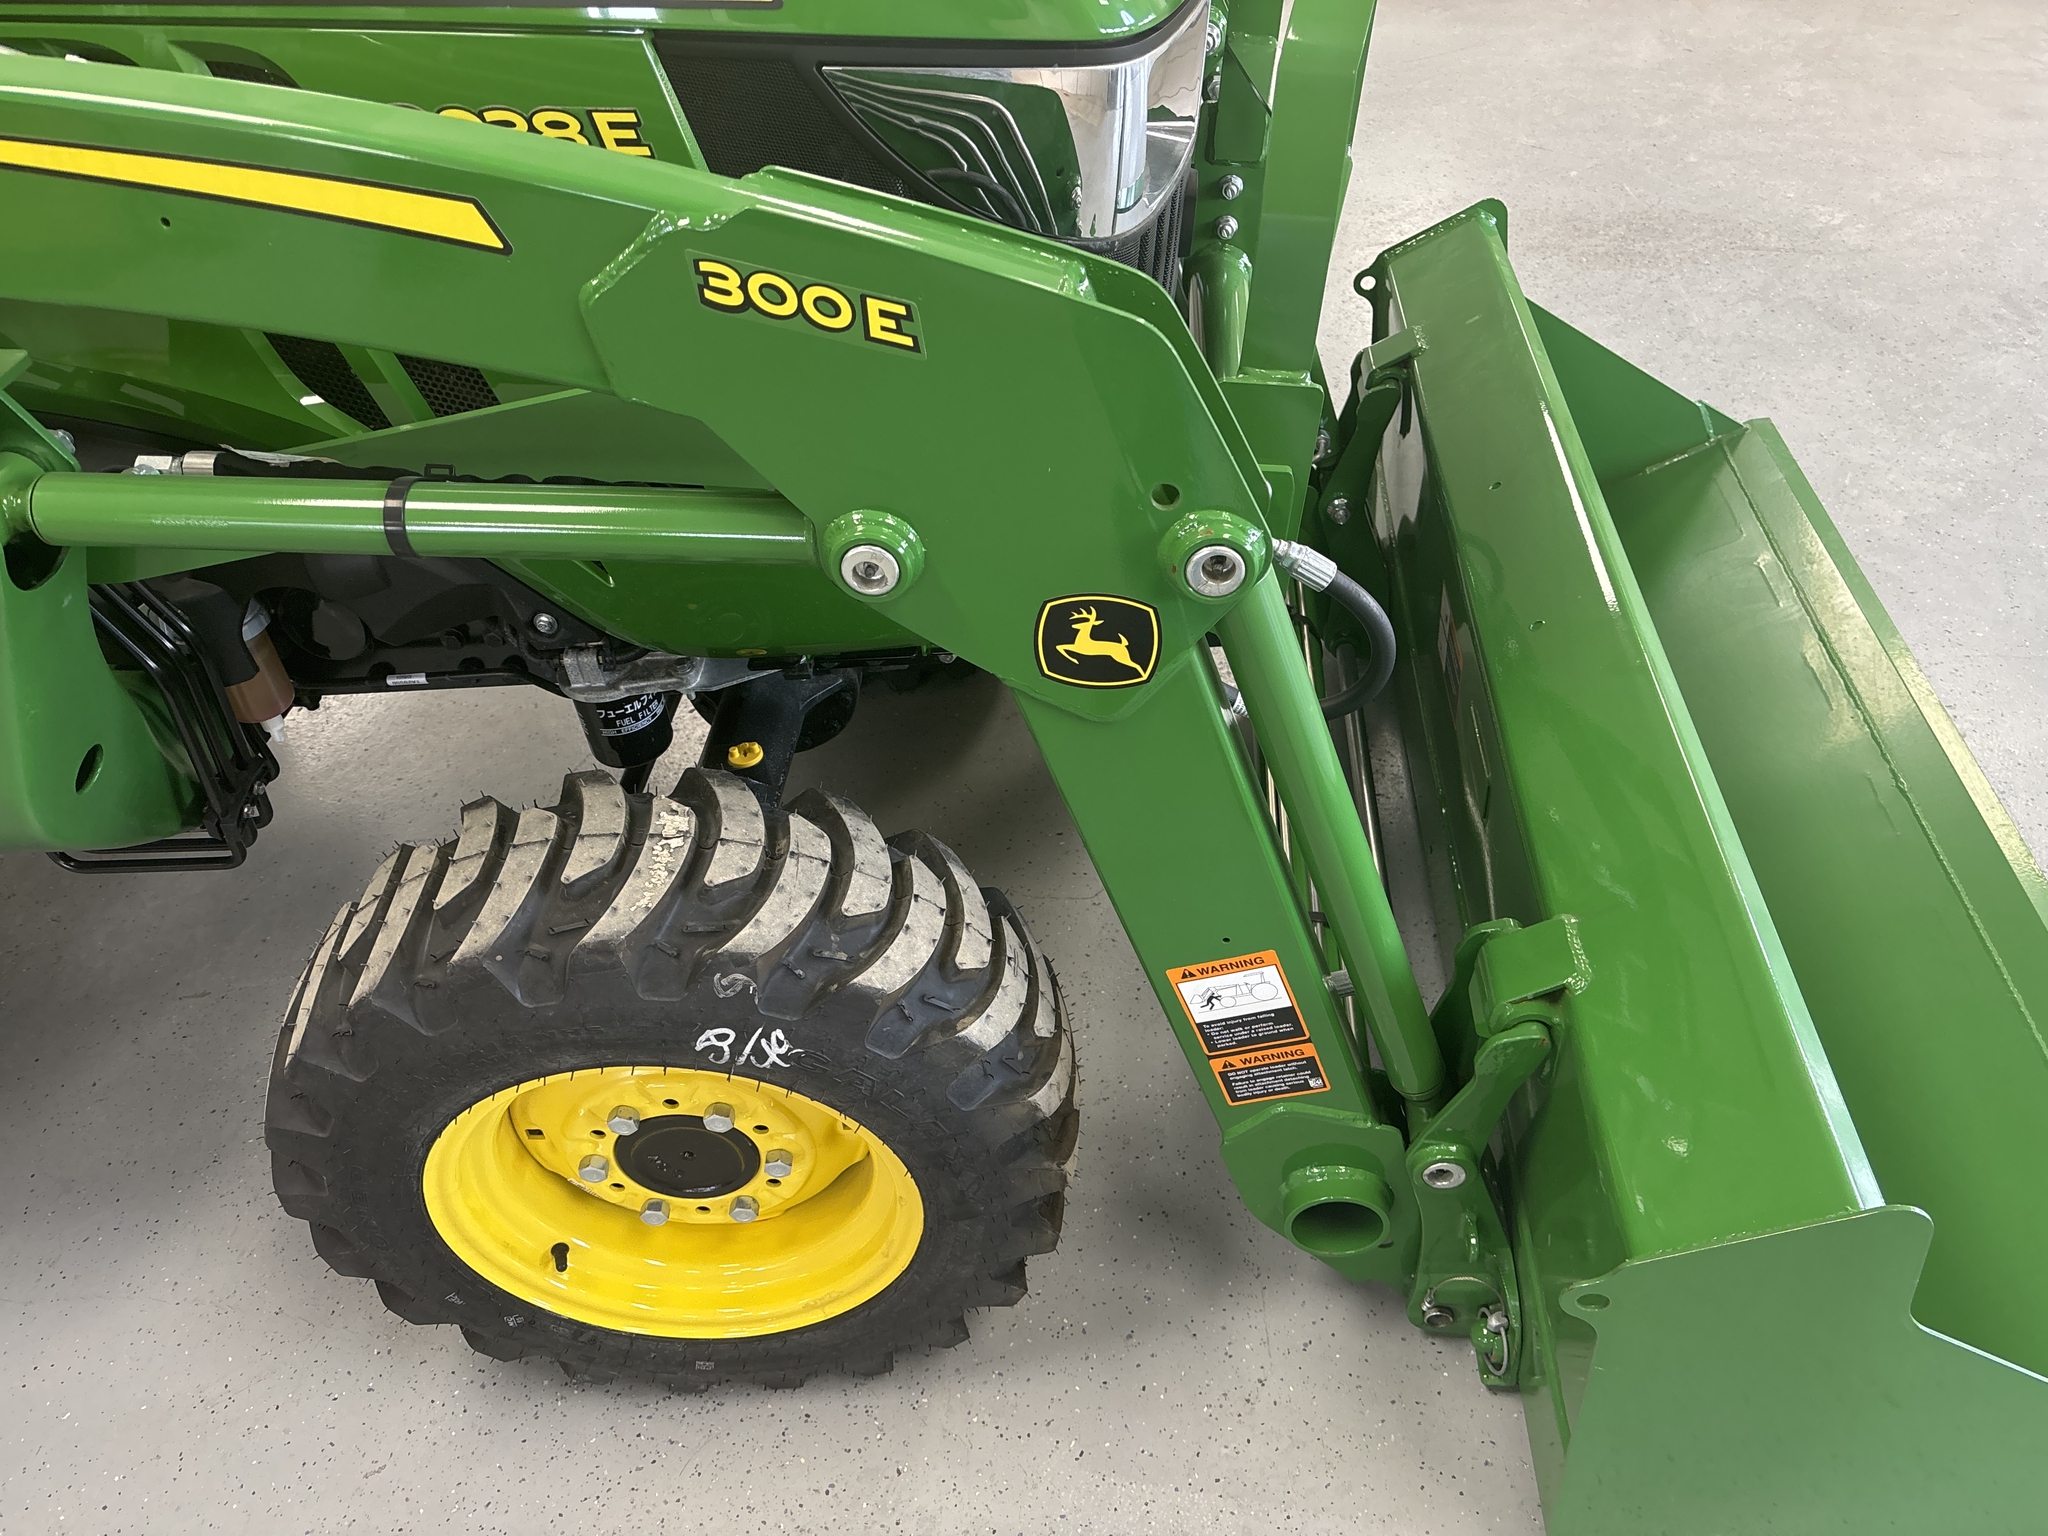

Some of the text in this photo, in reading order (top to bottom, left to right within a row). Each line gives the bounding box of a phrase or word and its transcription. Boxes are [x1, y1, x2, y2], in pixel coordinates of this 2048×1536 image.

[596, 693, 656, 718] フューエルフィ
[616, 717, 636, 727] FUEL
[638, 699, 659, 720] FILTER
[1197, 956, 1265, 975] WARNING
[1239, 1048, 1305, 1066] WARNING
